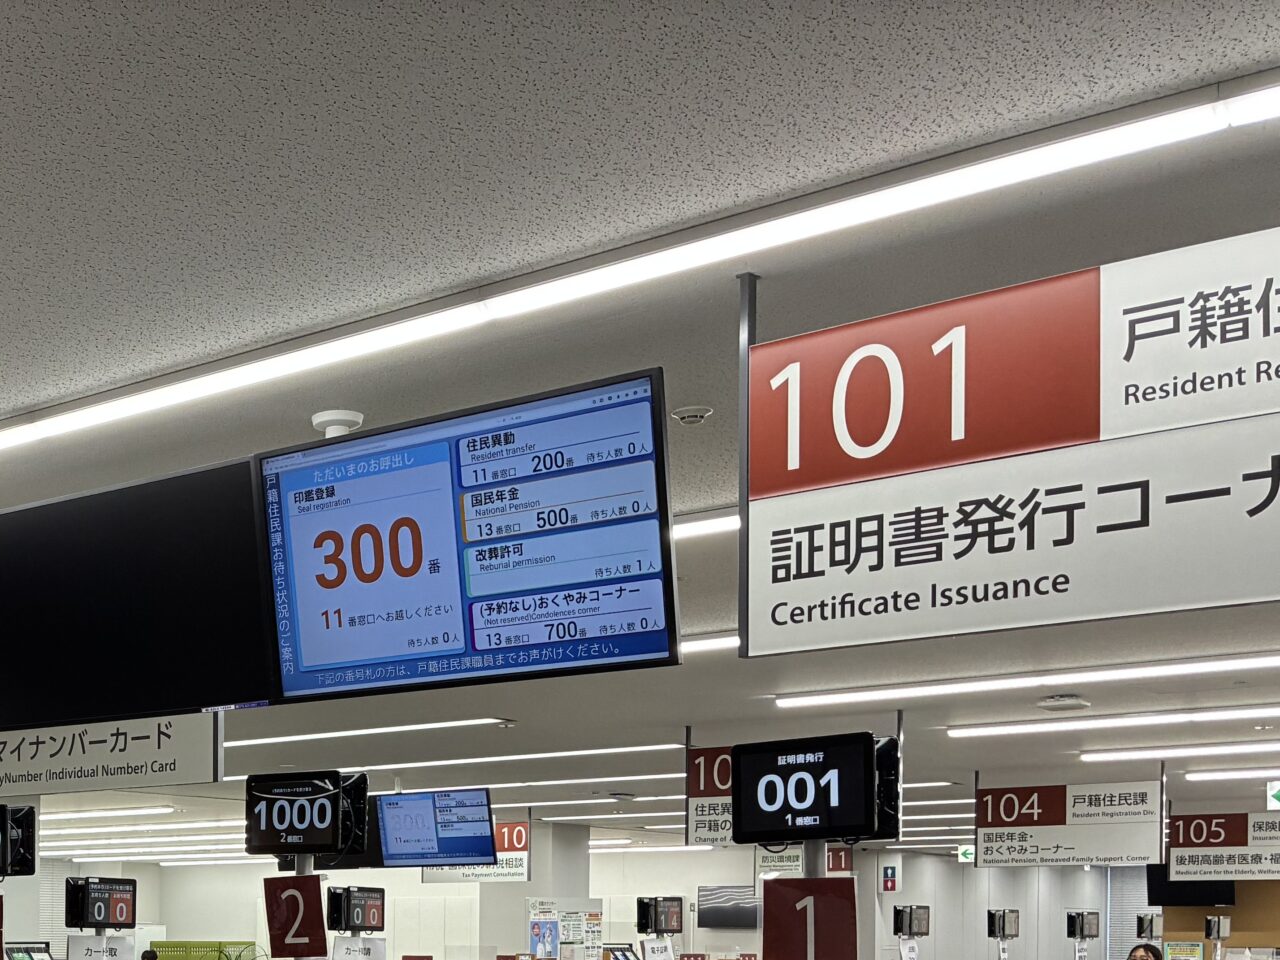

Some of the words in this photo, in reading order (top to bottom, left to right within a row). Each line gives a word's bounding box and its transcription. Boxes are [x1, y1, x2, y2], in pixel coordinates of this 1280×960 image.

[1123, 362, 1247, 406] Resident
[769, 325, 967, 472] 101
[467, 432, 515, 452] 住民異動
[471, 449, 505, 462] Resident
[506, 443, 536, 457] transfer
[314, 452, 415, 483] ただいまのお呼出し
[472, 468, 487, 483] 11
[492, 468, 516, 480] 番窓口
[531, 451, 565, 473] 200
[586, 448, 623, 463] 待ち人数
[628, 442, 636, 455] 0
[293, 485, 336, 504] 印鑑登録
[297, 503, 312, 513] Seal
[313, 497, 351, 511] registration
[471, 487, 520, 508] 国民年金
[475, 505, 507, 517] National
[509, 499, 540, 512] Pension
[477, 523, 493, 538] 13
[496, 523, 521, 535] 番窓口
[536, 507, 569, 529] 500
[591, 505, 627, 520] 待ち人数
[632, 501, 640, 513] 0
[313, 516, 424, 589] 300
[427, 559, 440, 574] 番
[475, 543, 524, 562] 改葬許可
[479, 560, 511, 572] Reburial
[512, 554, 555, 569] permission
[595, 562, 632, 578] 待ち人数
[770, 588, 920, 627] Certificate
[930, 572, 1070, 610] Issuance
[321, 608, 343, 629] 11
[348, 604, 453, 627] 番窓口へお越しください
[408, 635, 439, 648] 待ち人数
[486, 633, 502, 647] 13
[504, 634, 529, 645] 番窓口
[544, 621, 577, 641] 700
[599, 622, 636, 635] 待ち人数
[640, 618, 648, 629] 0
[778, 752, 825, 766] 証明書発行
[45, 768, 99, 782] (Individual
[101, 761, 147, 777] Number)
[150, 759, 176, 773] Card
[757, 769, 839, 812] 001
[254, 797, 332, 830] 1000
[983, 792, 1042, 823] 104
[1072, 792, 1148, 809] 戸籍住民課
[785, 814, 792, 826] 1
[280, 833, 287, 842] 2
[1175, 819, 1226, 844] 105
[983, 844, 1075, 856] おくやみコーナー
[94, 902, 105, 920] 0
[116, 902, 127, 921] 0
[281, 888, 310, 944] 2
[354, 908, 362, 924] 0
[370, 908, 378, 924] 0
